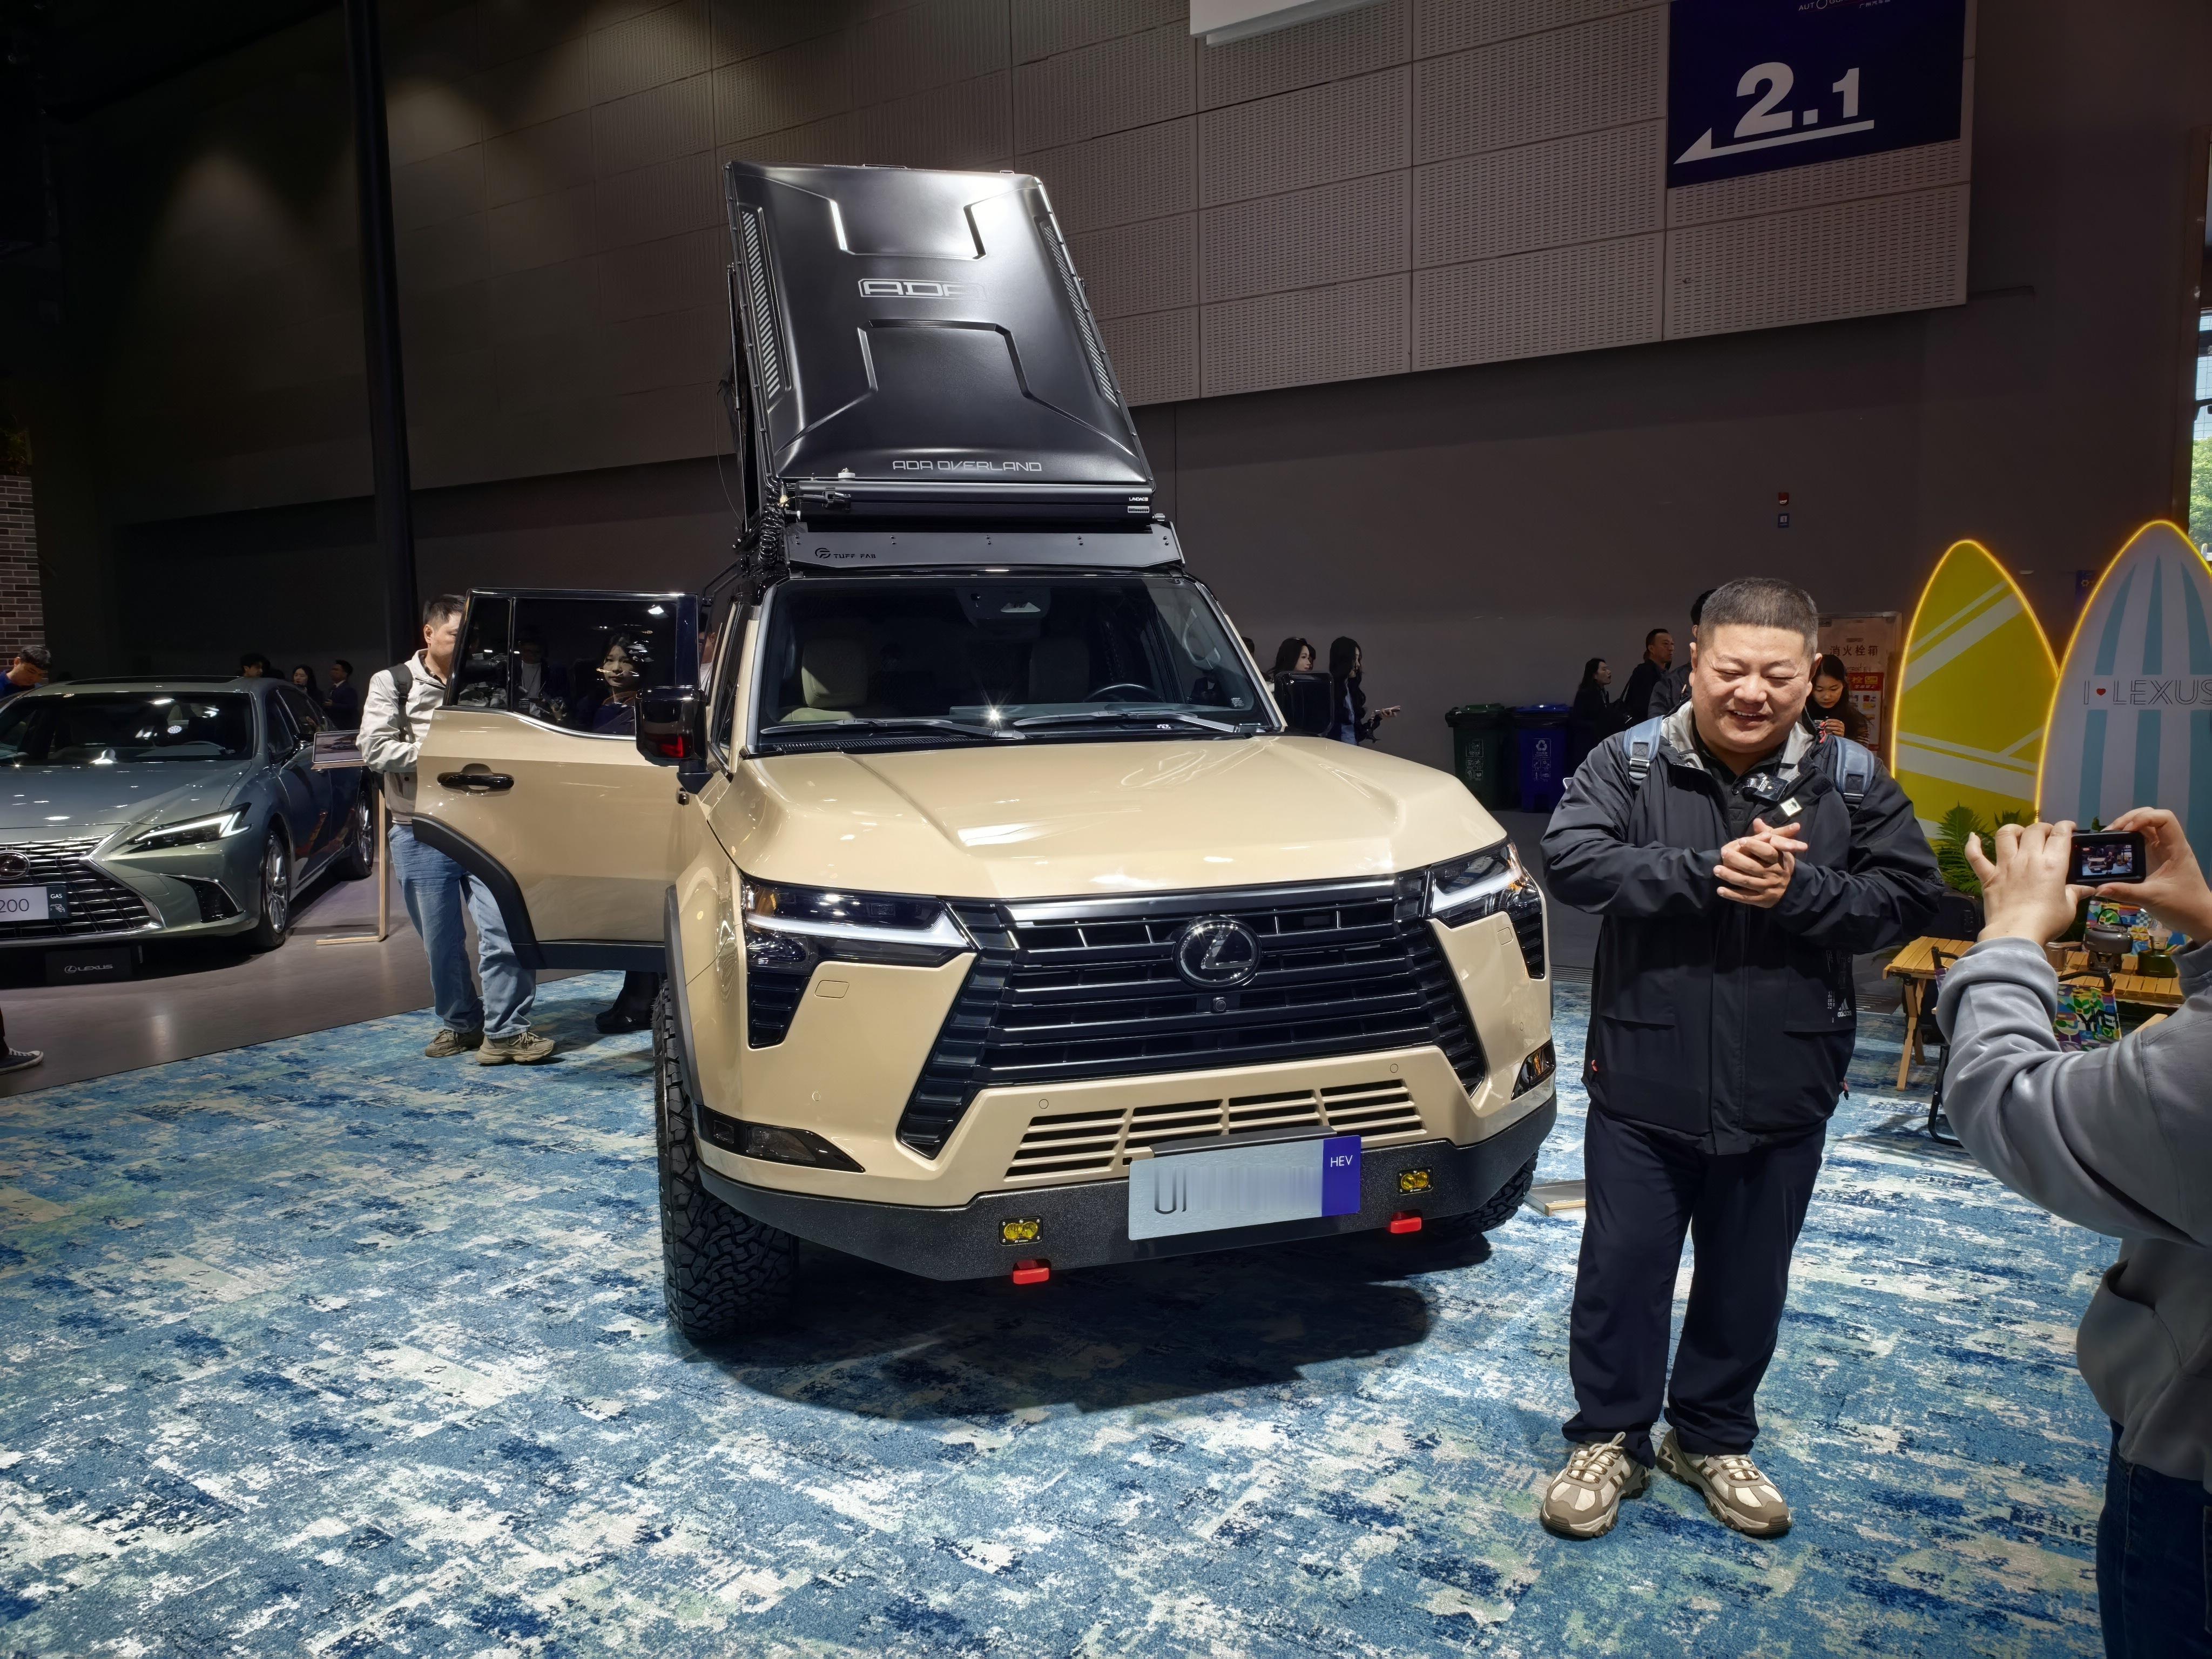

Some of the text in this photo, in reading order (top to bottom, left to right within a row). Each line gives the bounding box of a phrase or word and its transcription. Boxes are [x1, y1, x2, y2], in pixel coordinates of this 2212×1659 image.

[1734, 62, 1859, 138] 2.1
[892, 461, 1042, 471] ADA OVERLAND
[1330, 1155, 1353, 1168] HEV
